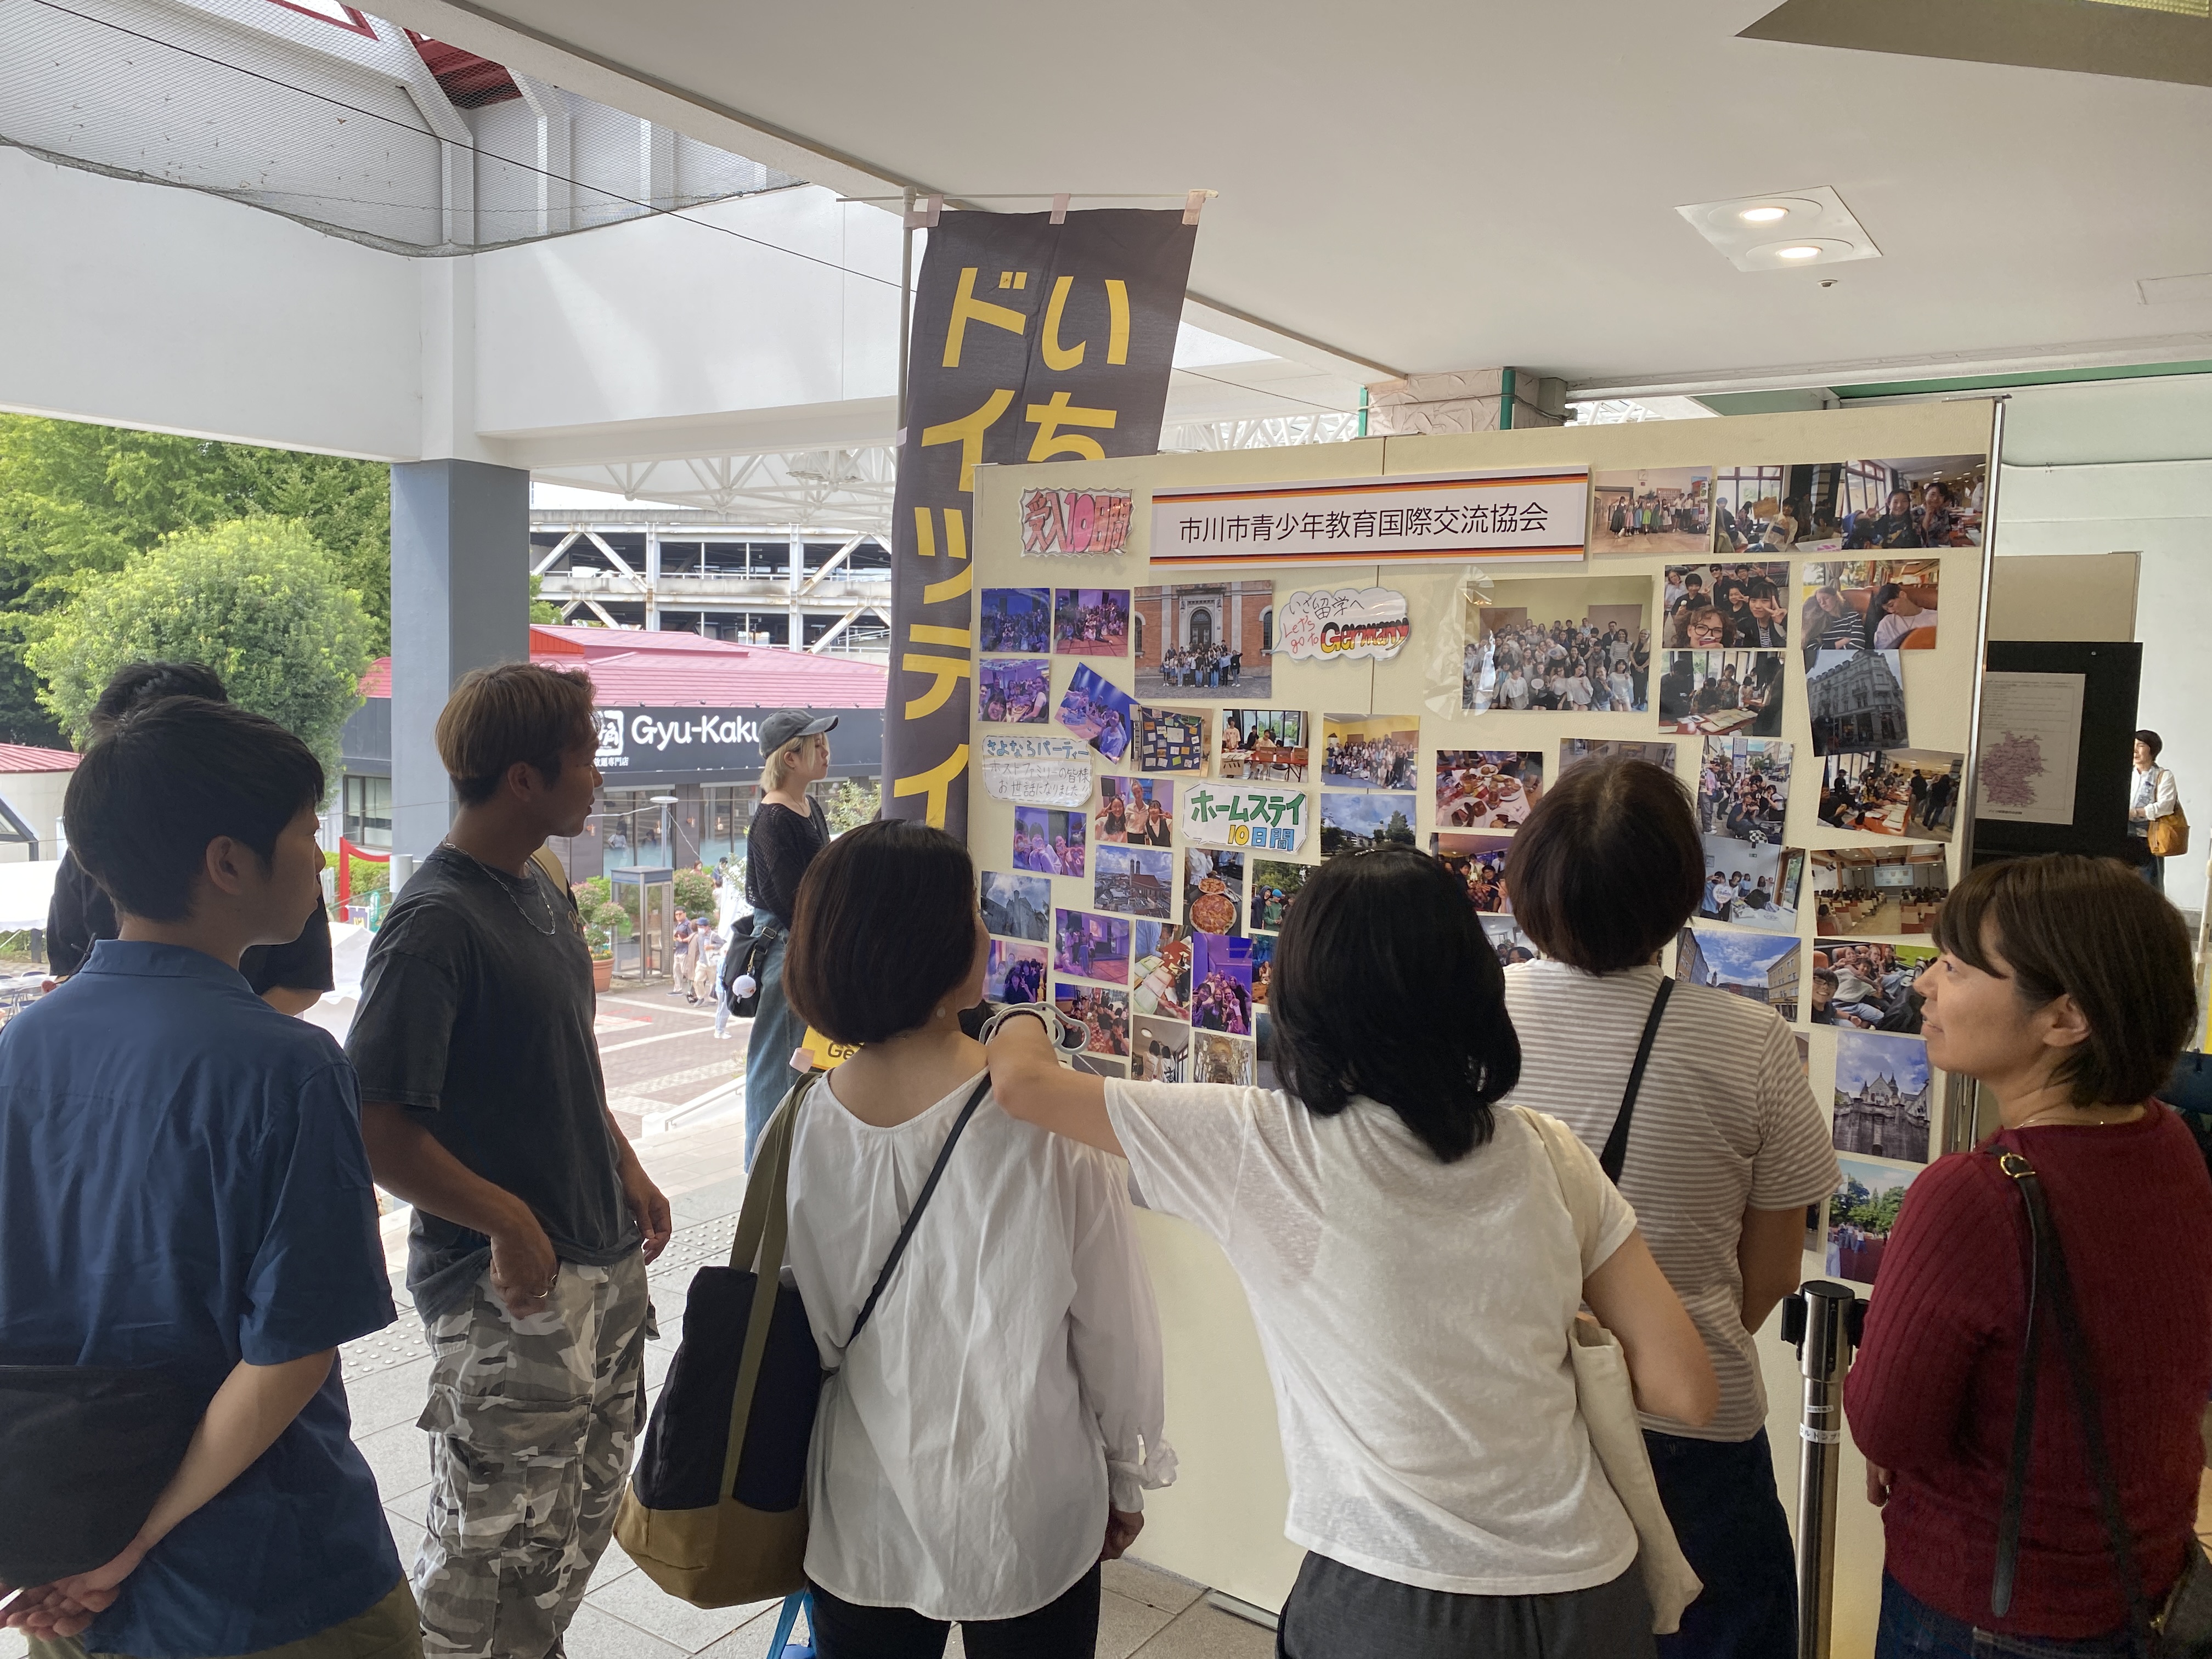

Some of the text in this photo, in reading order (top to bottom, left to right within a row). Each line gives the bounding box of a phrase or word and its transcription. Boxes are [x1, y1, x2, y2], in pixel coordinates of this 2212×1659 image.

[1025, 490, 1132, 553] 受入10日間
[1179, 501, 1548, 545] 市川市青少年教育国際交流協会
[1283, 615, 1315, 638] Let's
[1291, 617, 1409, 654] go to Germany
[988, 740, 1089, 759] さよならパーティー
[990, 760, 1091, 783] ホストファミリーの皆様
[1191, 790, 1306, 828] ホームステイ
[1227, 824, 1295, 851] 10日間
